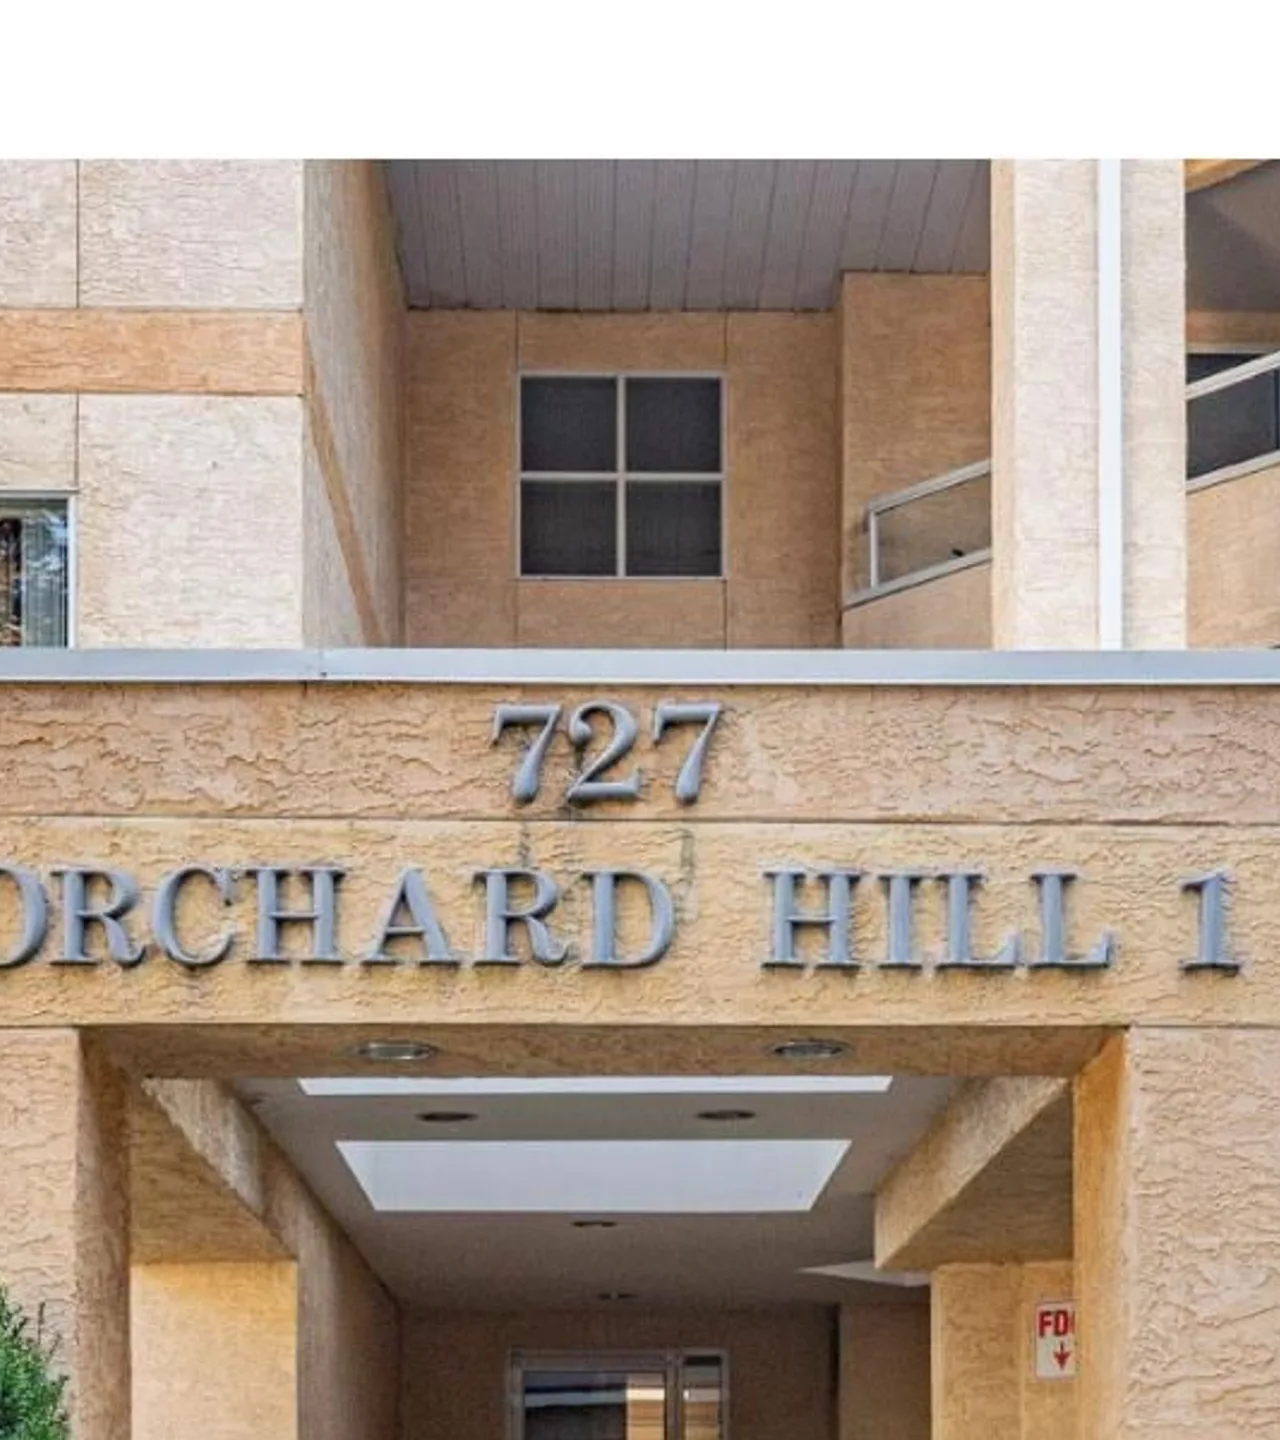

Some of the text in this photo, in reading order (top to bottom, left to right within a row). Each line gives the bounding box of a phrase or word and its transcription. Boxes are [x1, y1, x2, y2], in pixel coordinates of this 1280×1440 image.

[490, 701, 721, 803] 727
[761, 869, 1117, 971] HILL
[1180, 869, 1240, 974] 1
[1038, 1310, 1075, 1338] FD
